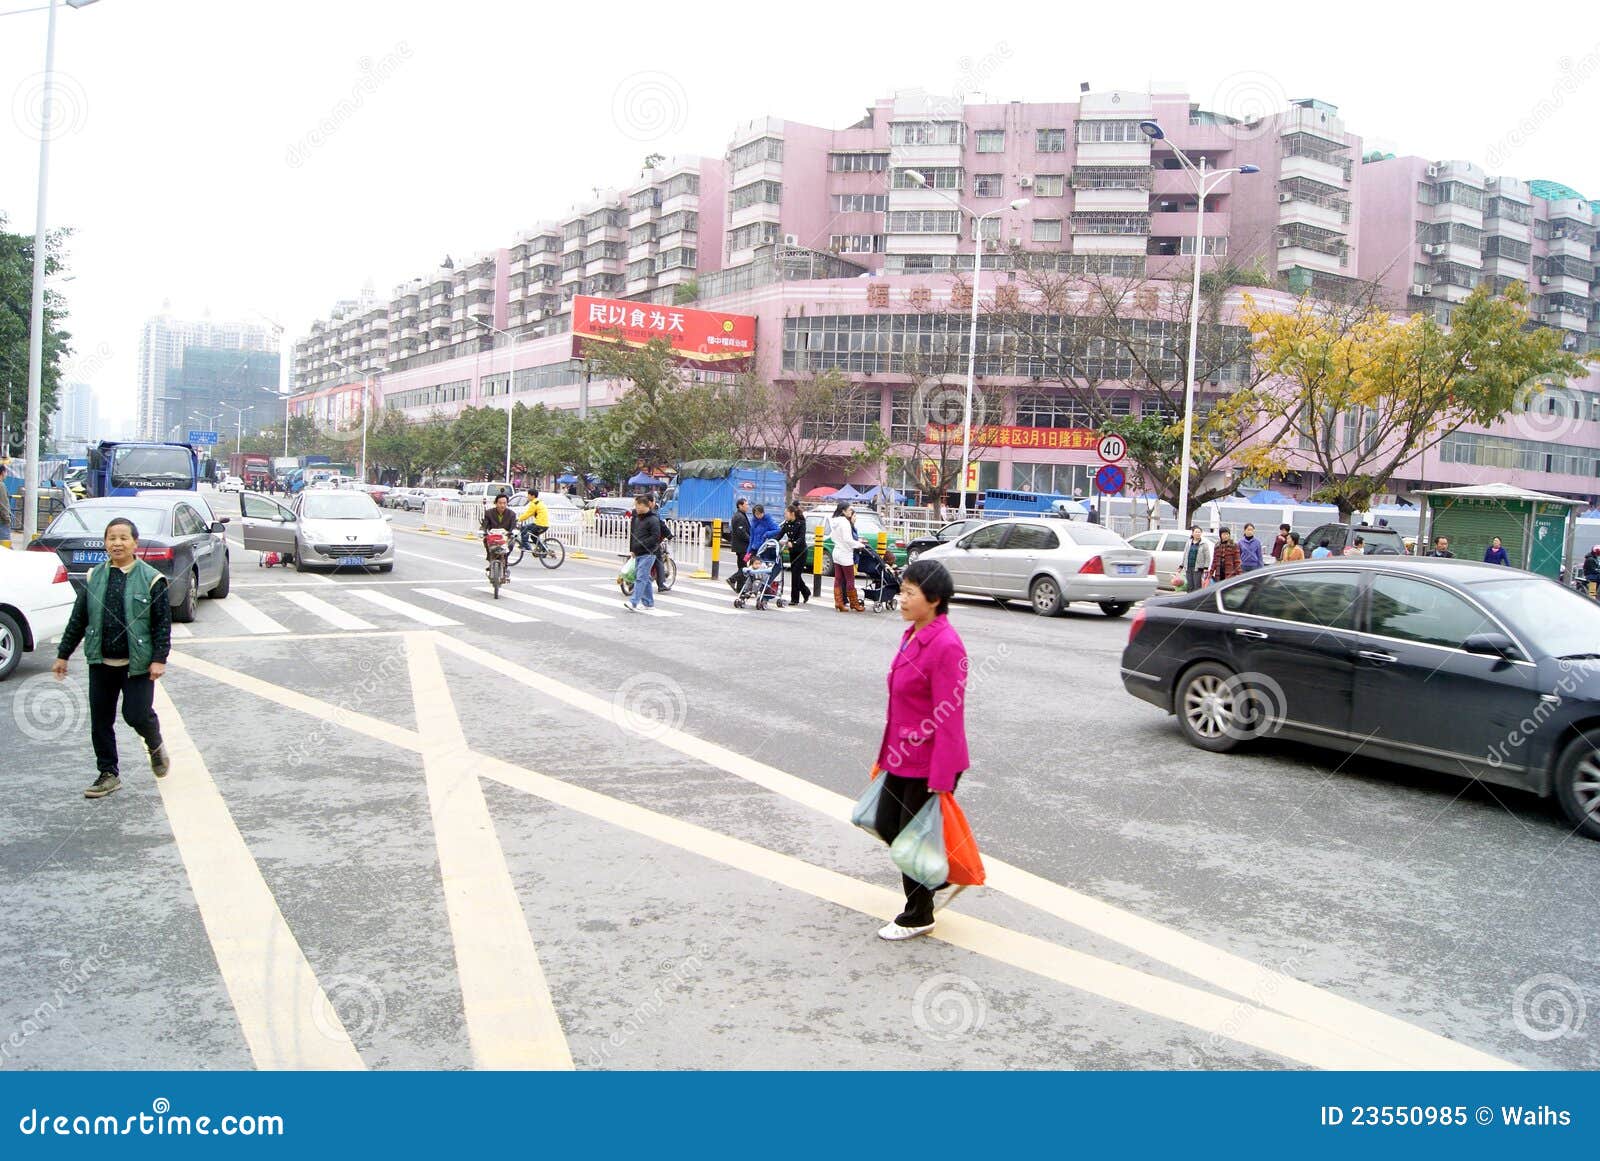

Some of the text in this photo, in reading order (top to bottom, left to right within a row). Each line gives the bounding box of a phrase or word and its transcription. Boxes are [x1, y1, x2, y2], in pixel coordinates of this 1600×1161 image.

[589, 303, 685, 332] 民以食为天
[1103, 441, 1121, 457] 40
[129, 480, 175, 488] FORLAND
